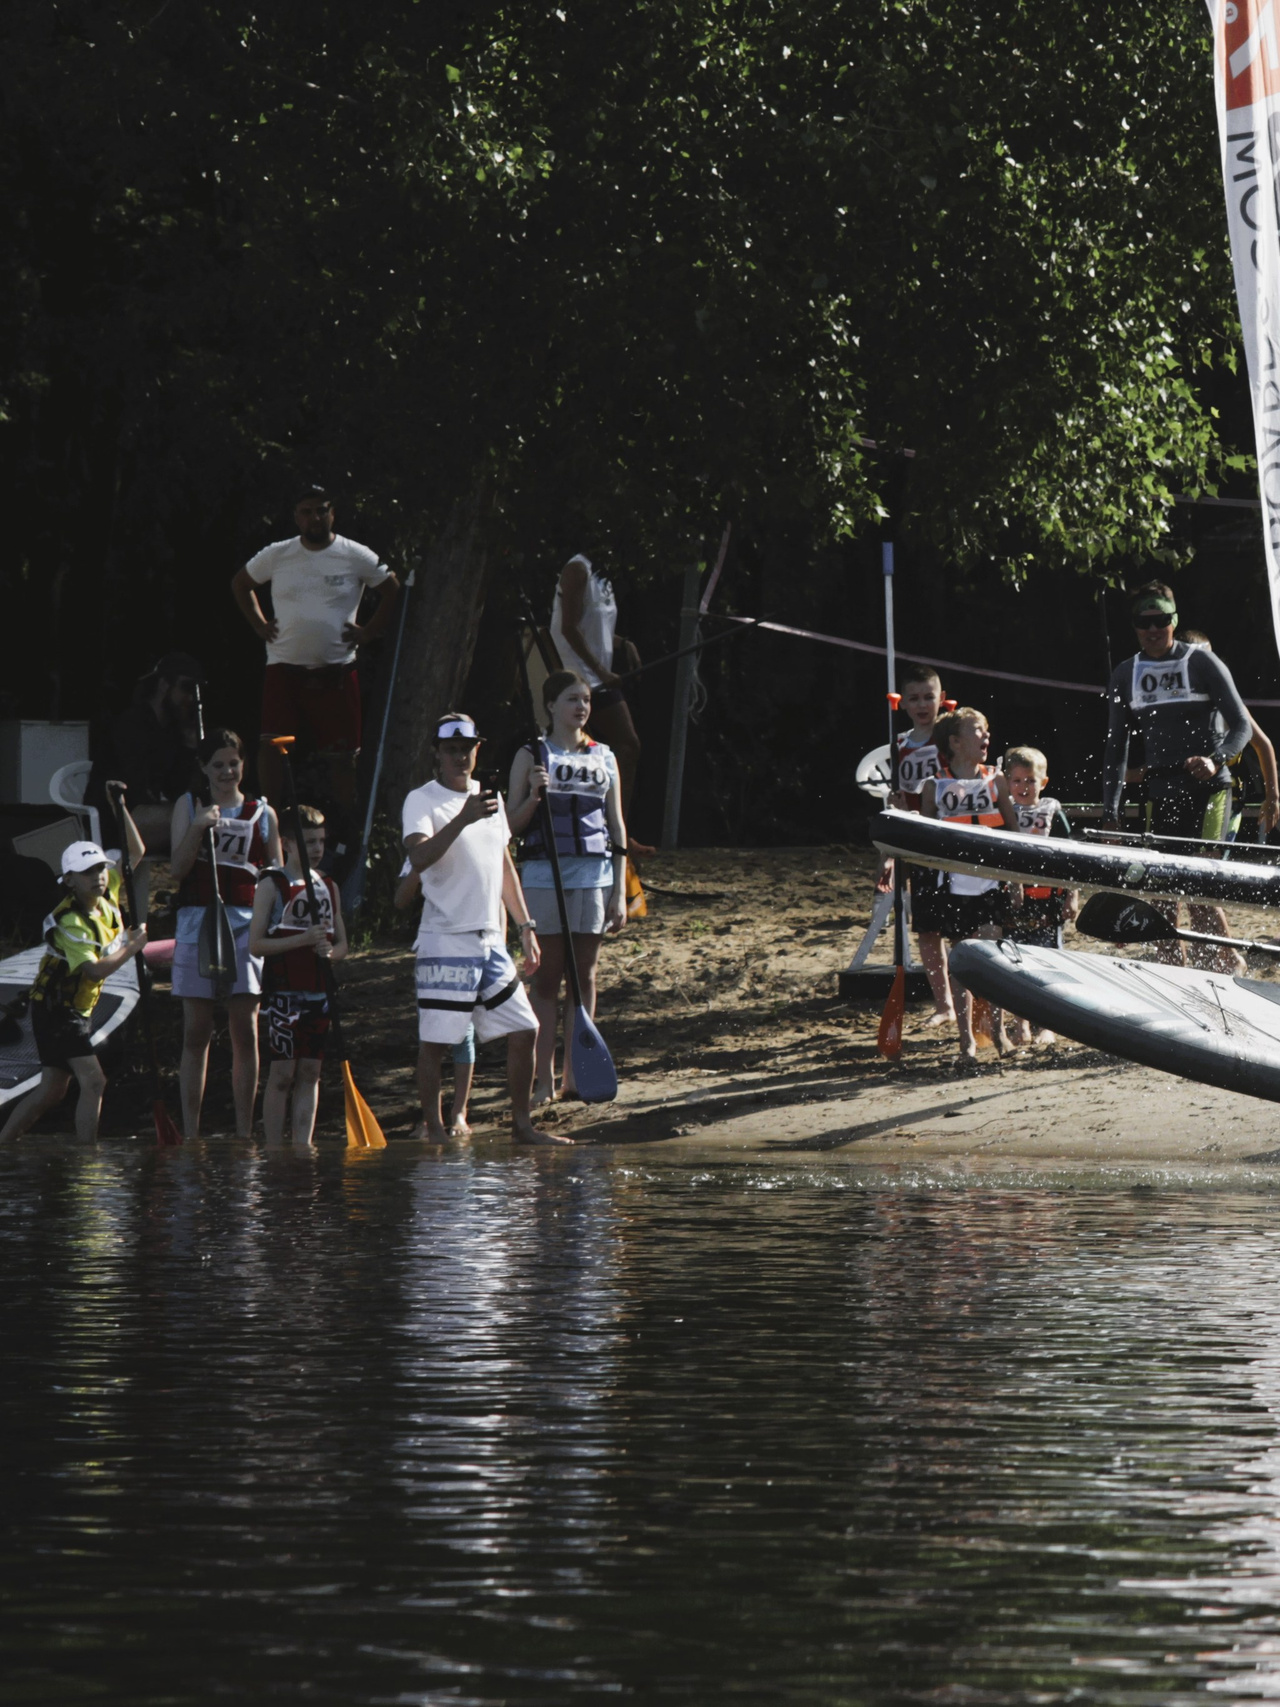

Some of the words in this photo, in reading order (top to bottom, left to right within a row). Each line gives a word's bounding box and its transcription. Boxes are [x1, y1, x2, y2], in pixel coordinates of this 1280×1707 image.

[1141, 671, 1186, 694] 041
[555, 763, 607, 786] 040
[901, 757, 938, 781] 015
[942, 789, 990, 812] 045
[1013, 811, 1048, 830] 55
